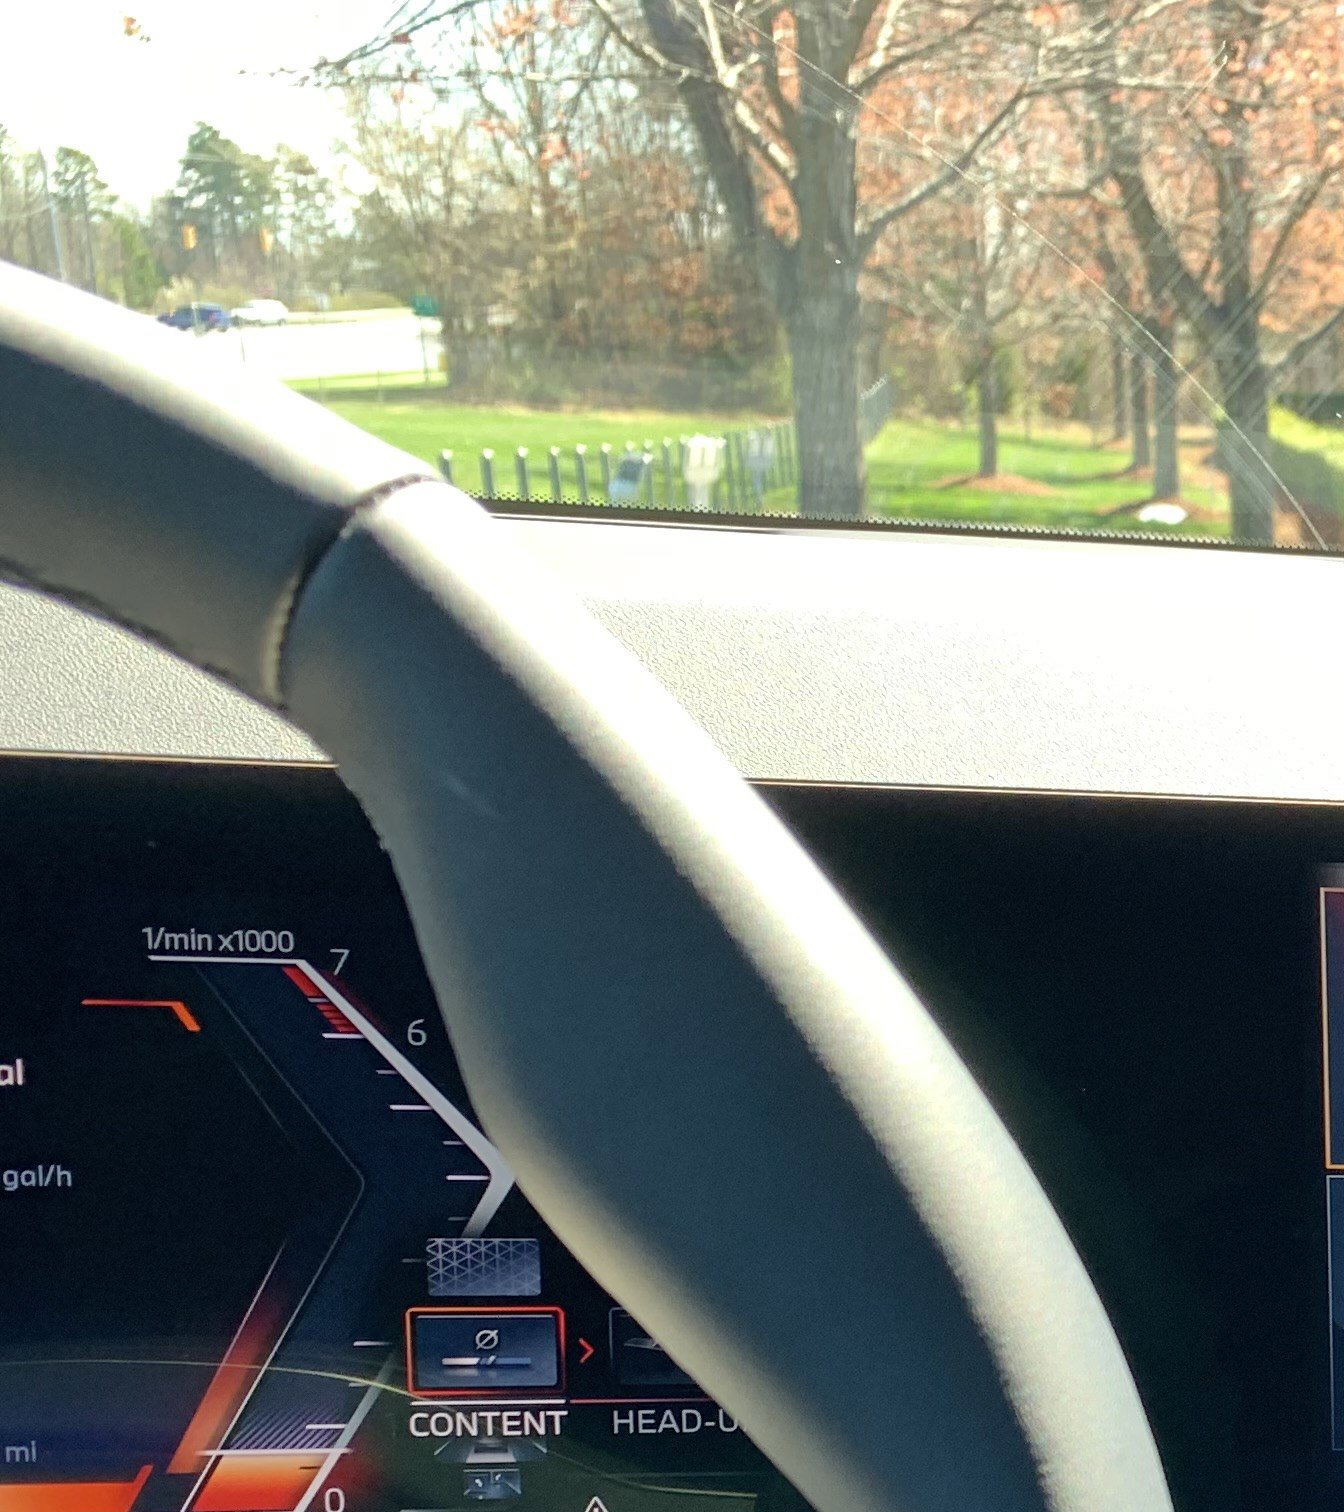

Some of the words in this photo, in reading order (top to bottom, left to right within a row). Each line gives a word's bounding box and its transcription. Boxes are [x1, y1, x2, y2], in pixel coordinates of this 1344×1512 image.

[141, 926, 213, 953] 1/min
[217, 929, 295, 954] x1000
[329, 949, 350, 976] 7
[406, 1018, 427, 1046] 6
[2, 1164, 73, 1192] gal/h
[409, 1410, 569, 1438] CONTENT
